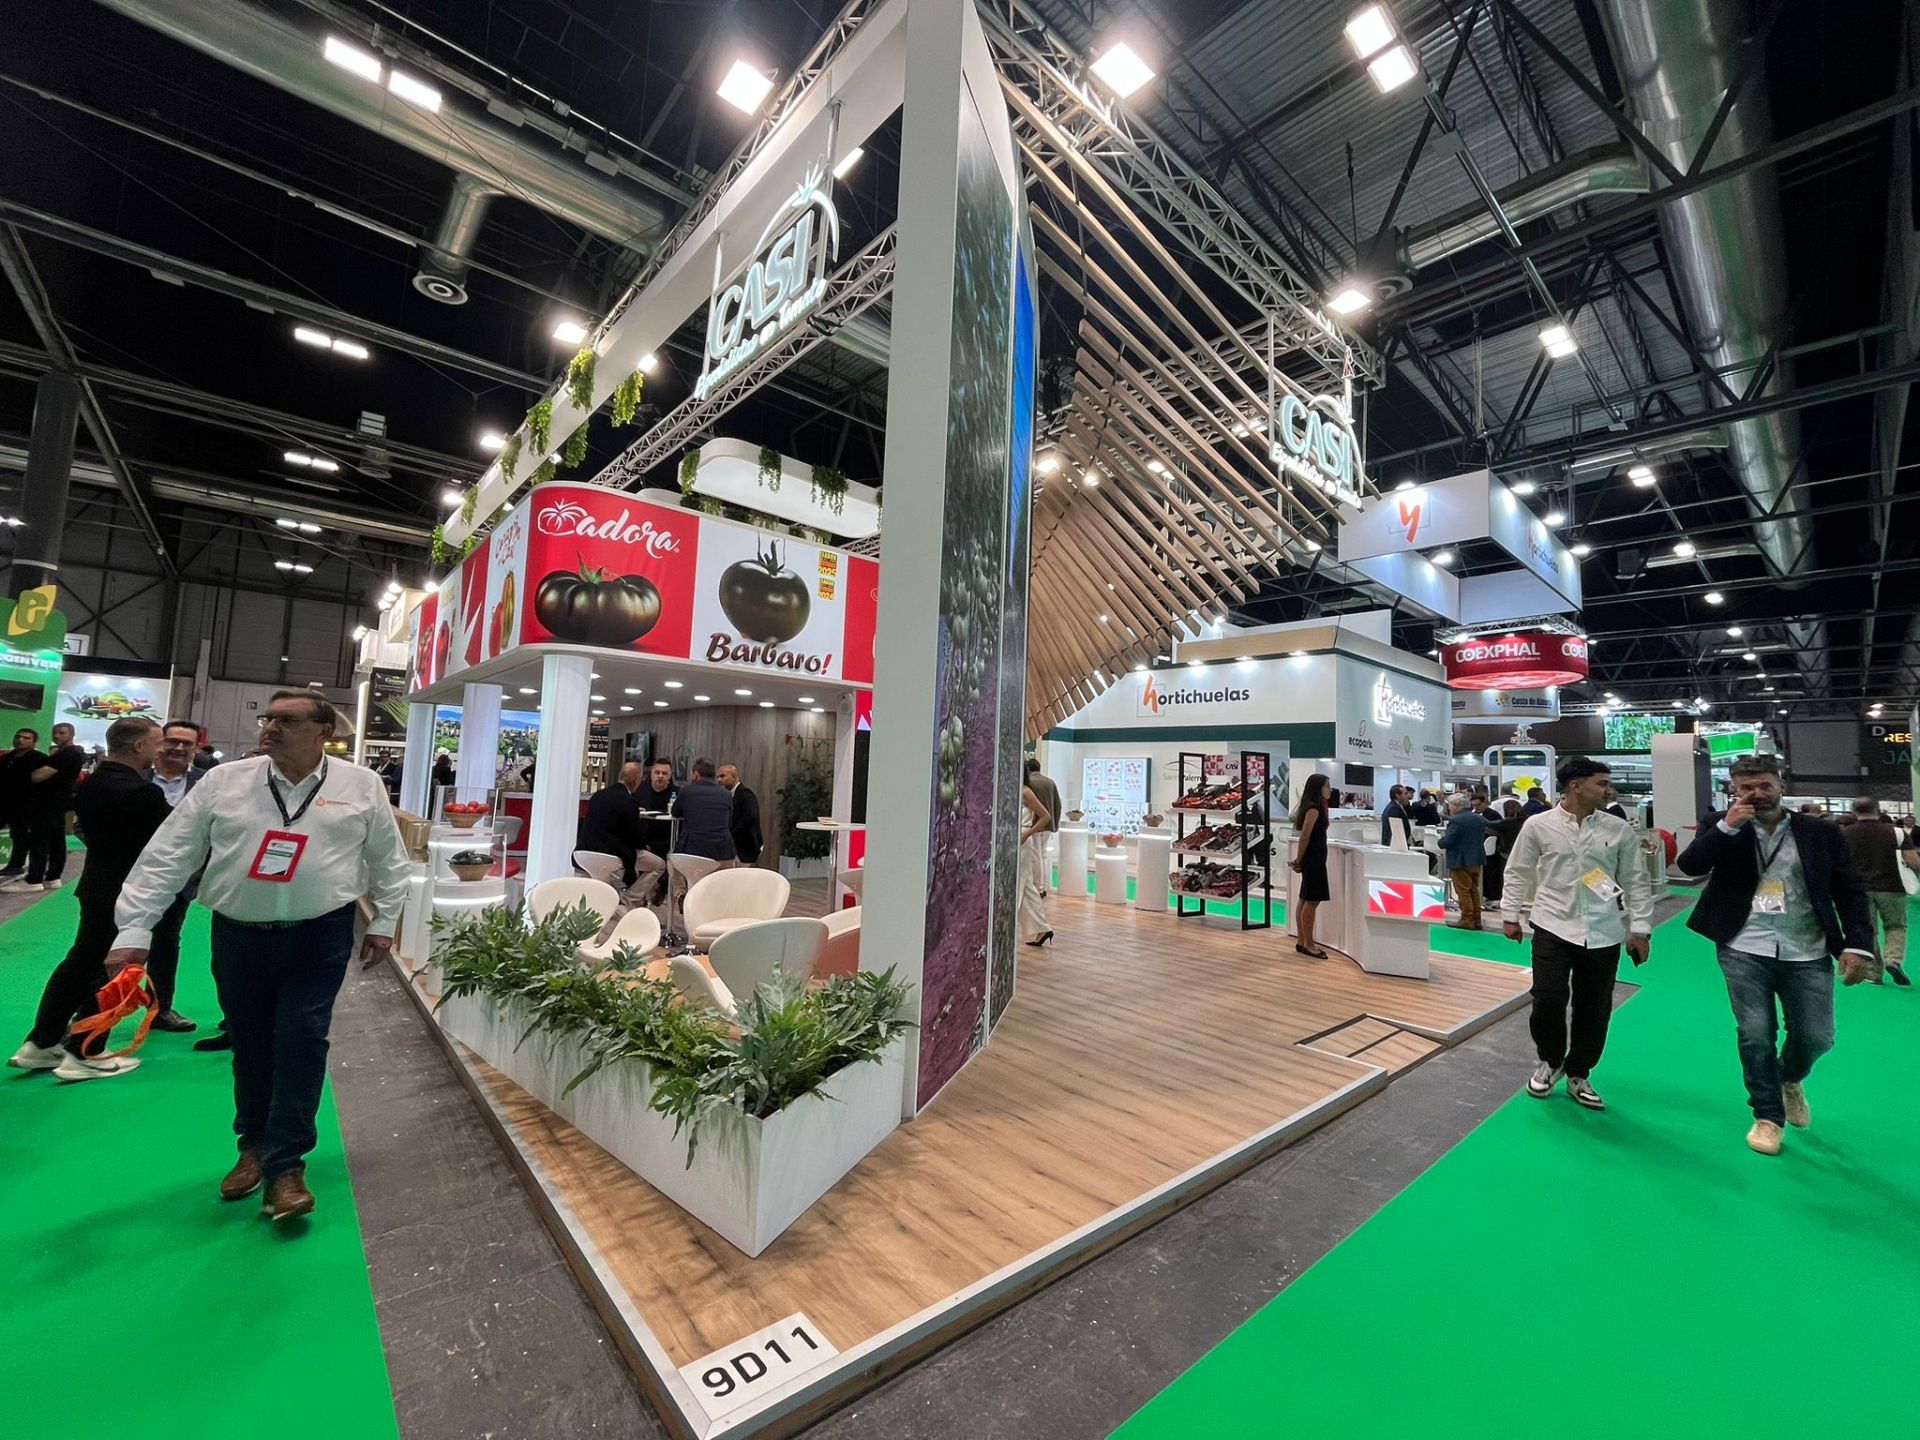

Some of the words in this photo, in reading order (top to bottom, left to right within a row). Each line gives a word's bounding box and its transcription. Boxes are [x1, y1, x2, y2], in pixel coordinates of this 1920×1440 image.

[708, 209, 815, 360] CASI
[1280, 394, 1351, 485] CASI
[818, 567, 838, 577] 2025
[1456, 642, 1541, 663] COEXPHAL
[1143, 674, 1250, 713] hortichuelas
[1348, 736, 1373, 750] ecopark
[1872, 726, 1886, 736] D
[701, 1326, 819, 1398] 9D11
